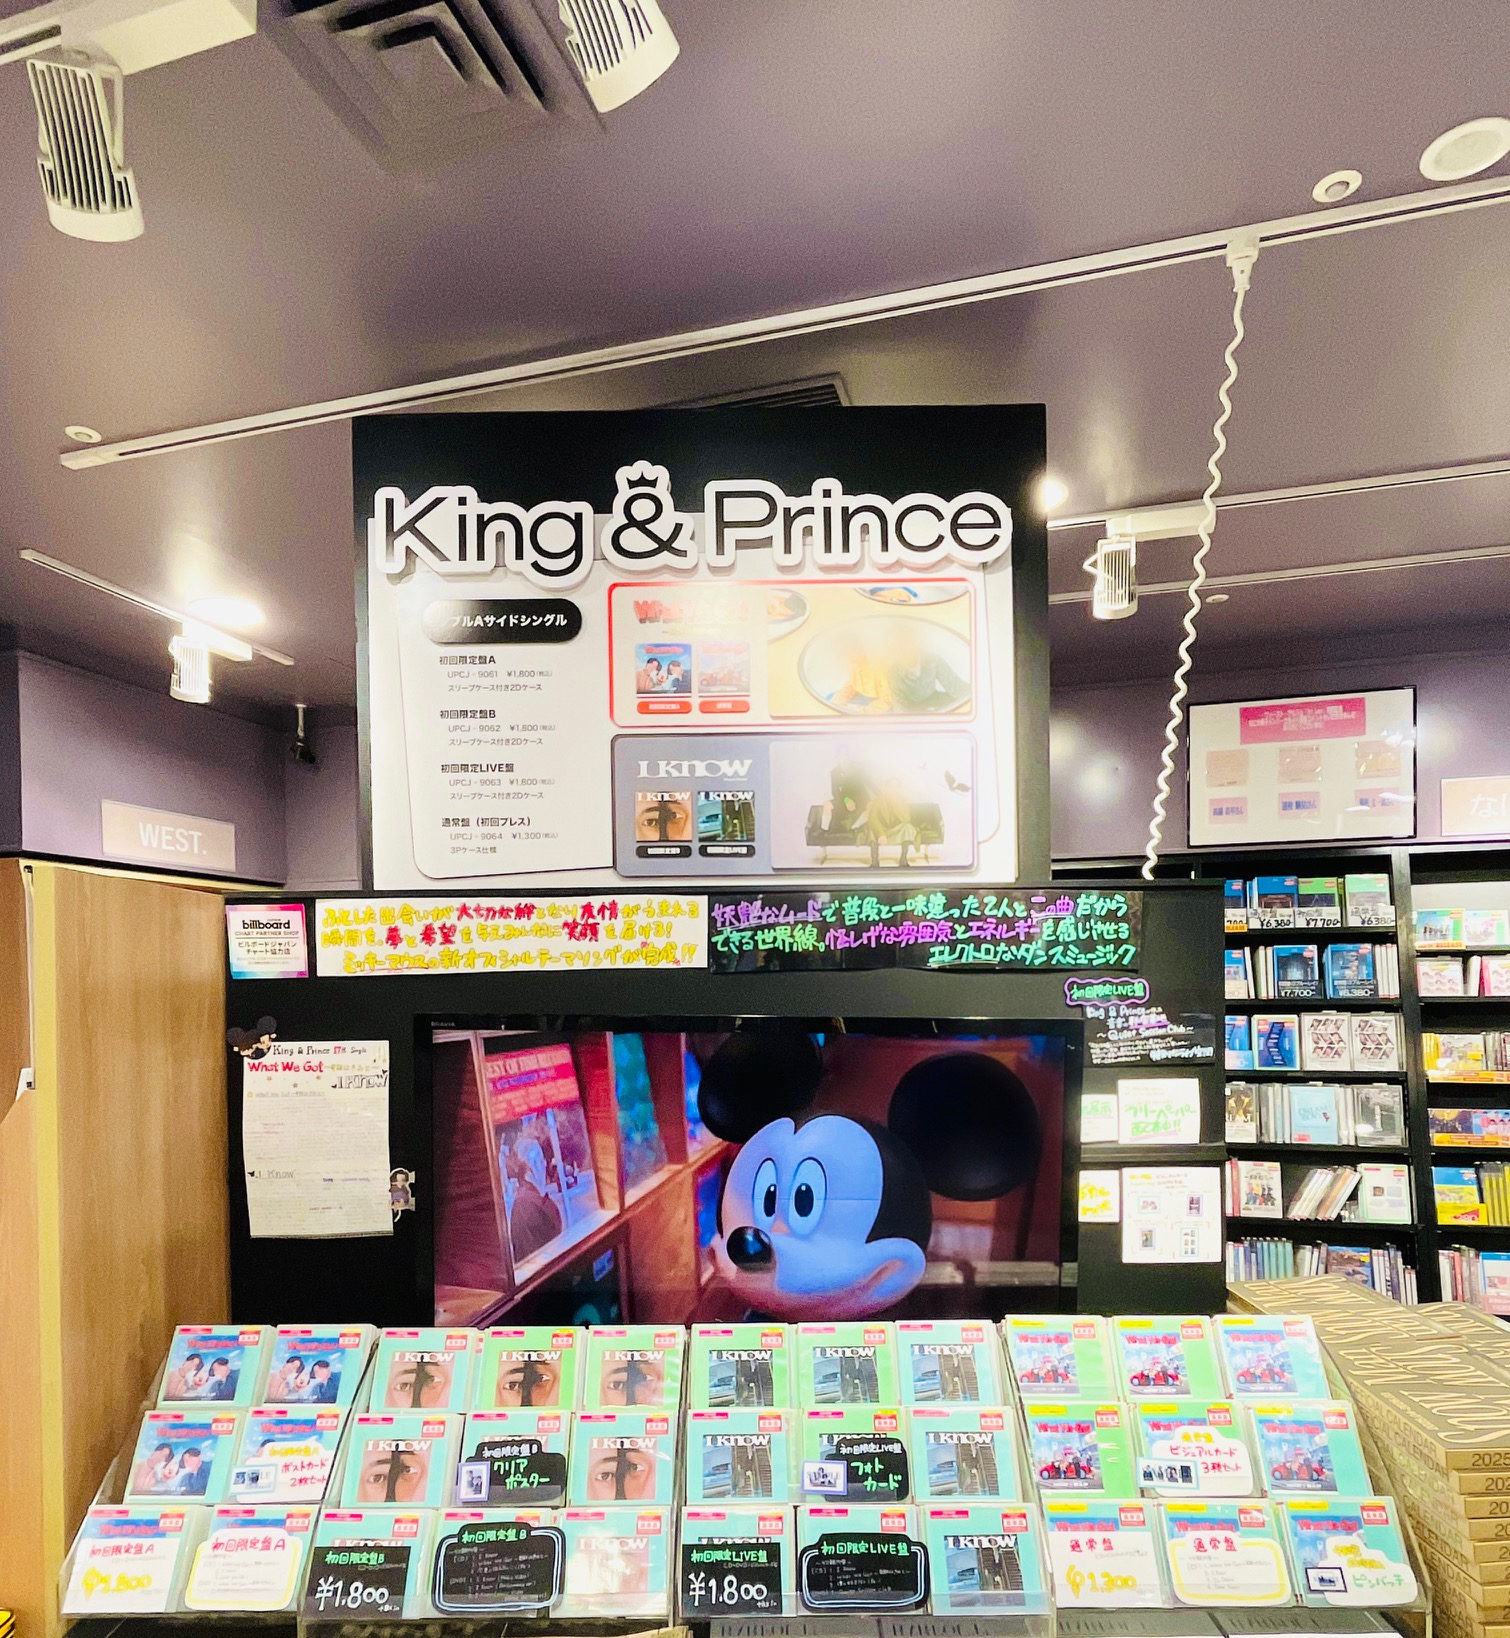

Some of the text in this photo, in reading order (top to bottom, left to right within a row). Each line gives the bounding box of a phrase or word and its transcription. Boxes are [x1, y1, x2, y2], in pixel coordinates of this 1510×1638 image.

[383, 487, 1004, 578] King & Prince
[439, 655, 496, 666] 初回限定盤A
[477, 670, 499, 679] 9061
[440, 709, 496, 720] 初回限定盤B
[478, 724, 501, 733] 9062
[441, 763, 515, 774] 初回限定LIVE盤
[479, 778, 502, 787] 9063
[138, 821, 208, 856] WEST.
[242, 919, 291, 930] billboard
[237, 941, 297, 949] ビルボードジャパン
[246, 948, 291, 956] チャート協力店
[247, 1061, 280, 1072] What
[281, 1061, 300, 1072] We
[1169, 1445, 1237, 1457] ビジュアルカード
[493, 1459, 528, 1474] クリア
[850, 1459, 884, 1475] フォト
[505, 1473, 550, 1490] ポスター
[863, 1474, 902, 1492] カード
[211, 1535, 286, 1552] 初回限定盤A
[820, 1540, 910, 1556] 初回限定LIVE盤
[1070, 1538, 1114, 1552] 通常盤
[1193, 1536, 1238, 1552] 通常盤
[690, 1549, 768, 1564] 初回限定LIVE盤
